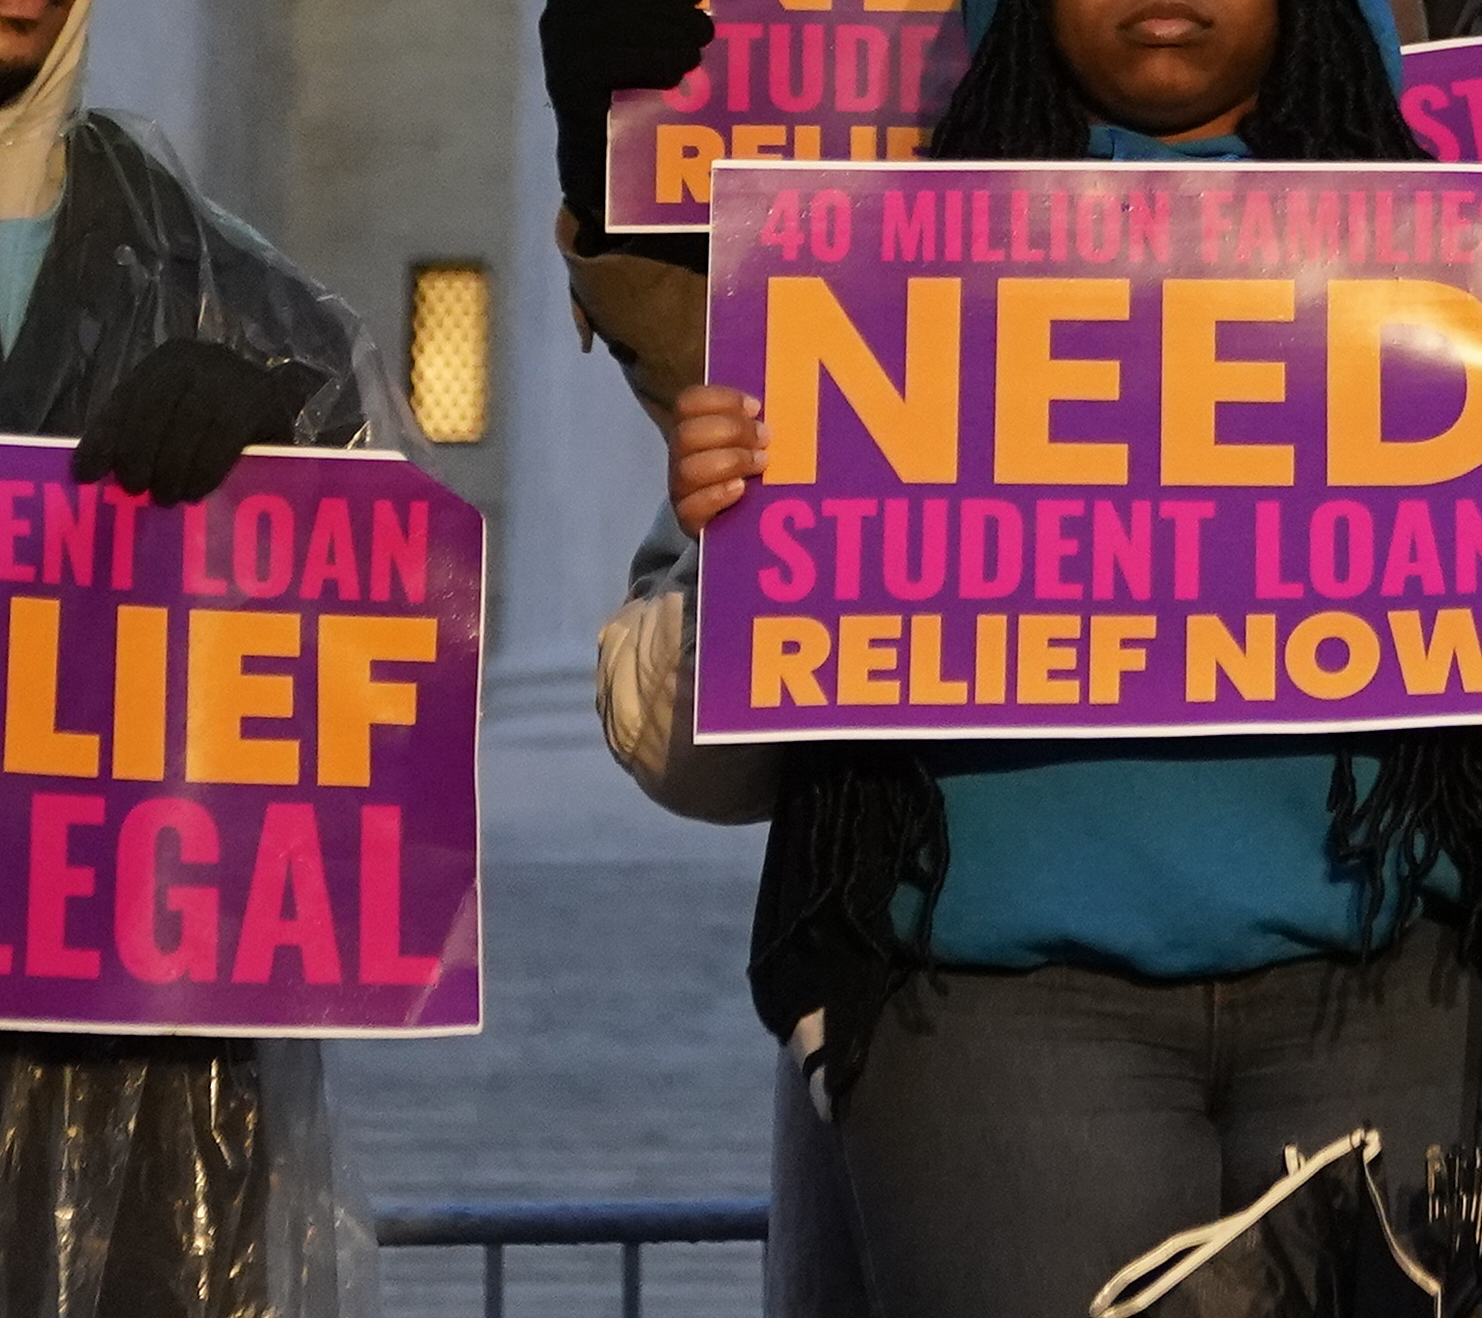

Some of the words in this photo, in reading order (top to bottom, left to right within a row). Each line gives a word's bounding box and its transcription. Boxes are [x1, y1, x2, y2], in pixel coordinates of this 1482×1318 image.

[660, 22, 938, 114] TUDE
[759, 185, 852, 264] 40
[880, 187, 1173, 265] MILLION
[183, 492, 429, 604] LOAN
[759, 499, 1215, 602] STUDENT
[749, 612, 1157, 708] RELIEF
